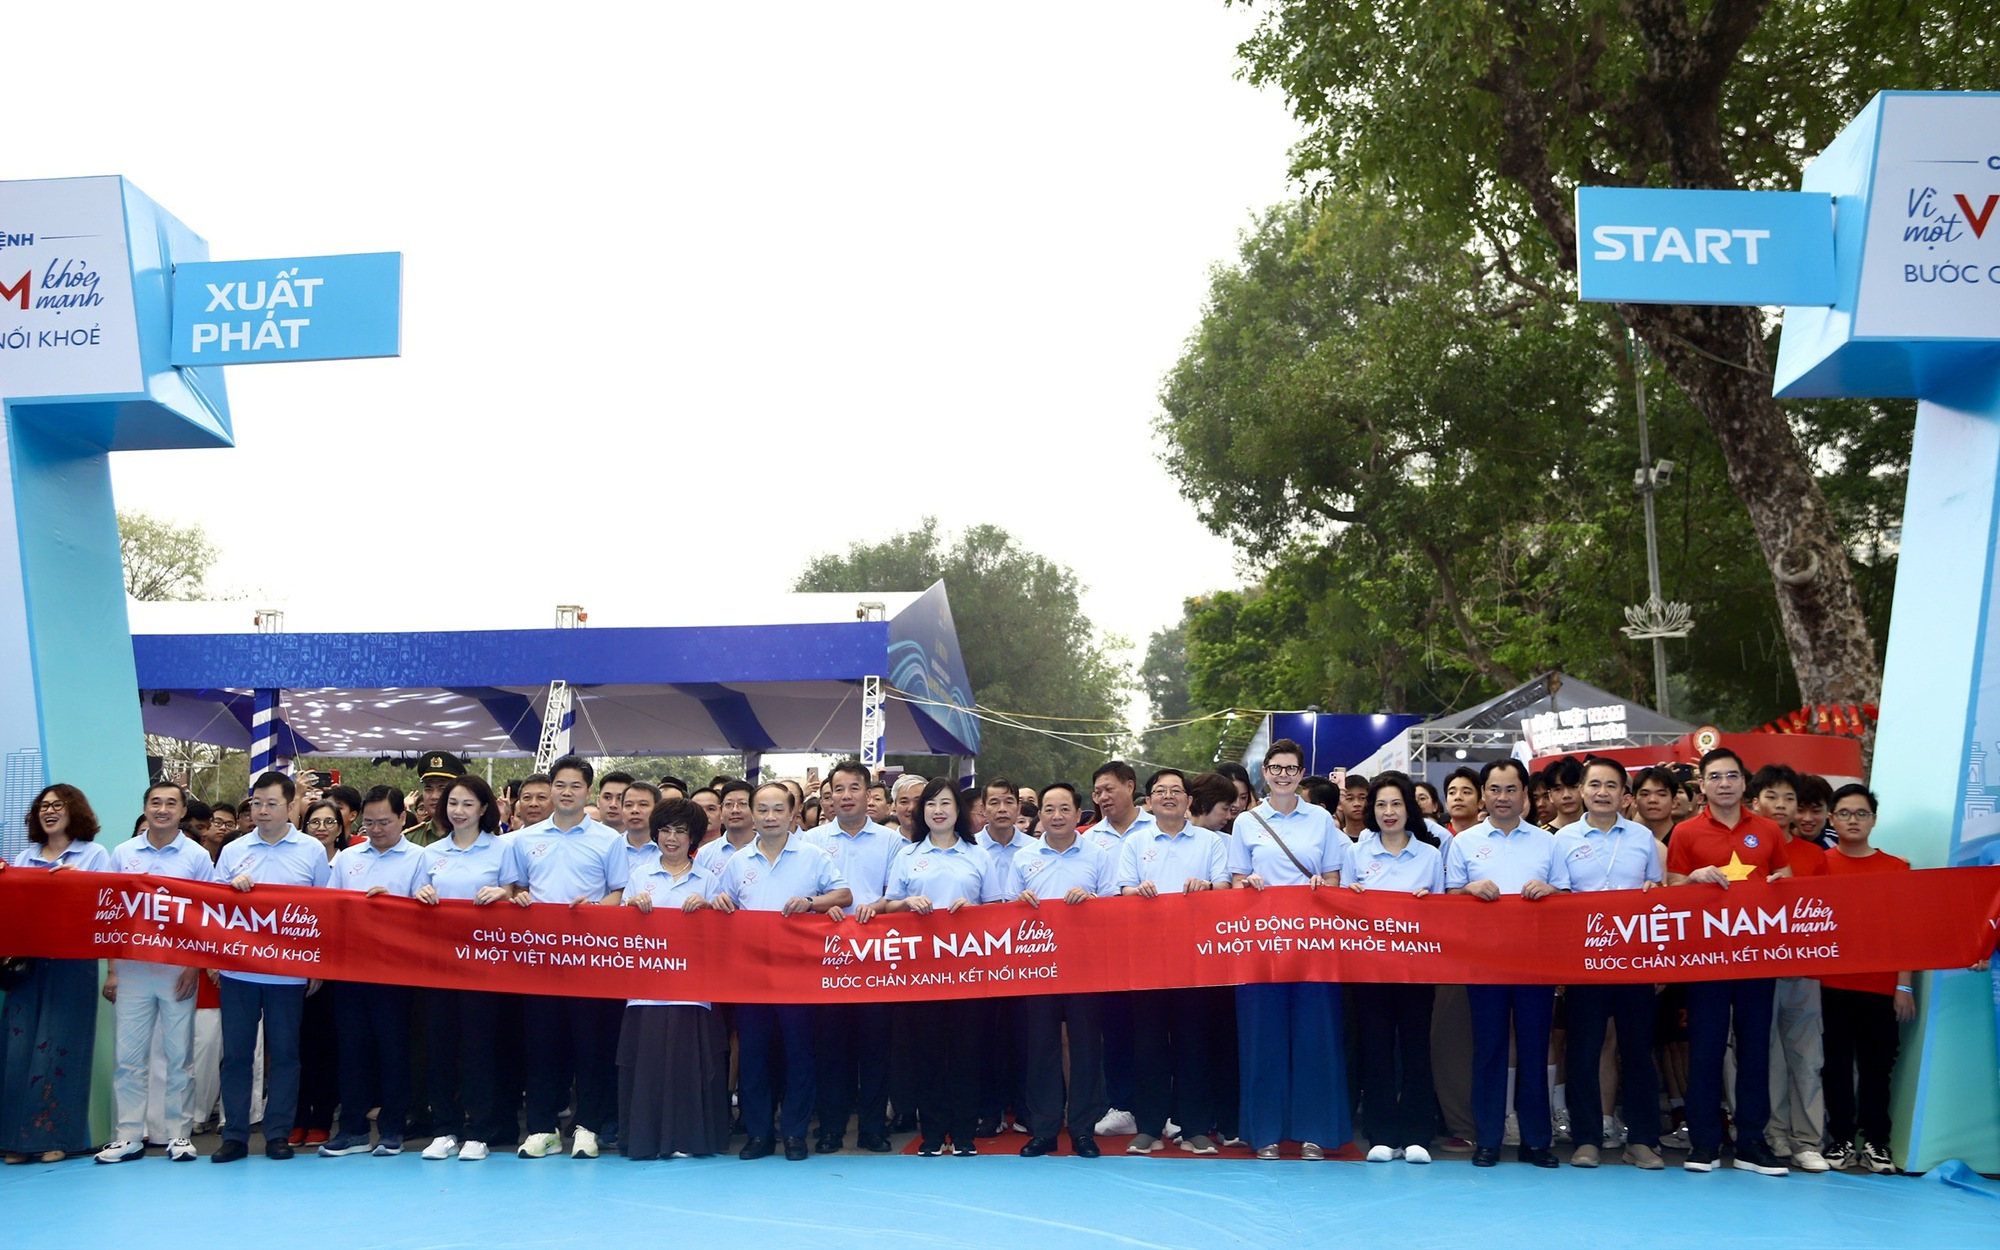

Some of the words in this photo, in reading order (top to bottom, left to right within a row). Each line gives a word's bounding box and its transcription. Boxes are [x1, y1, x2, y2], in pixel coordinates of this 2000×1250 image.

[1908, 187, 1938, 218] Vì
[1953, 194, 2000, 240] V
[1593, 226, 1770, 264] START
[1903, 214, 1964, 250] một
[40, 258, 98, 289] khỏe
[1904, 259, 1980, 283] BƯỚC
[36, 276, 104, 315] mạnh
[205, 267, 324, 312] XUẤT
[38, 323, 100, 348] KHOẺ
[192, 310, 310, 353] PHÁT
[99, 888, 114, 906] Vì
[120, 886, 192, 930] VIỆT
[202, 901, 278, 934] NAM
[1792, 897, 1832, 918] khỏe
[95, 905, 125, 925] một
[282, 903, 318, 924] khỏe
[1216, 916, 1251, 934] CHỦ
[1255, 916, 1304, 934] ĐỘNG
[1310, 914, 1369, 931] PHÒNG
[1374, 918, 1420, 936] BỆNH
[1586, 912, 1604, 934] Vì
[1791, 910, 1838, 937] mạnh
[281, 917, 322, 940] mạnh
[473, 928, 506, 942] CHỦ
[510, 930, 557, 946] ĐỘNG
[562, 932, 618, 948] PHÒNG
[624, 934, 668, 952] BỆNH
[1016, 920, 1053, 940] khỏe
[1584, 928, 1619, 952] một
[1613, 904, 1691, 951] VIỆT
[1702, 905, 1787, 938] NAM
[94, 929, 128, 944] BƯỚC
[131, 932, 172, 948] CHÂN
[178, 938, 219, 954] XANH,
[223, 941, 248, 956] KẾT
[252, 944, 278, 959] NỐI
[824, 935, 841, 954] Vì
[849, 928, 922, 970] VIỆT
[933, 928, 1012, 958] NAM
[1015, 932, 1058, 958] mạnh
[1197, 938, 1212, 955] VÌ
[1218, 938, 1253, 956] MỘT
[1257, 936, 1292, 954] VIỆT
[1298, 938, 1335, 950] NAM
[1340, 936, 1386, 952] KHỎE
[1392, 940, 1442, 956] MẠNH
[1584, 953, 1628, 970] BƯỚC
[1632, 952, 1676, 968] CHÂN
[1680, 952, 1728, 966] XANH,
[1732, 946, 1758, 962] KẾT
[1764, 945, 1792, 960] NỐI
[1797, 942, 1840, 960] KHOẺ
[455, 944, 470, 959] VÌ
[474, 947, 509, 964] MỘT
[512, 949, 546, 966] VIỆT
[550, 952, 586, 966] NAM
[590, 952, 634, 968] KHỎE
[639, 957, 688, 973] MẠNH
[822, 950, 854, 970] một
[822, 972, 862, 989] BƯỚC
[866, 972, 906, 987] CHÂN
[911, 972, 955, 985] XANH,
[959, 968, 984, 982] KẾT
[988, 966, 1015, 980] NỐI
[1019, 962, 1058, 979] KHOẺ
